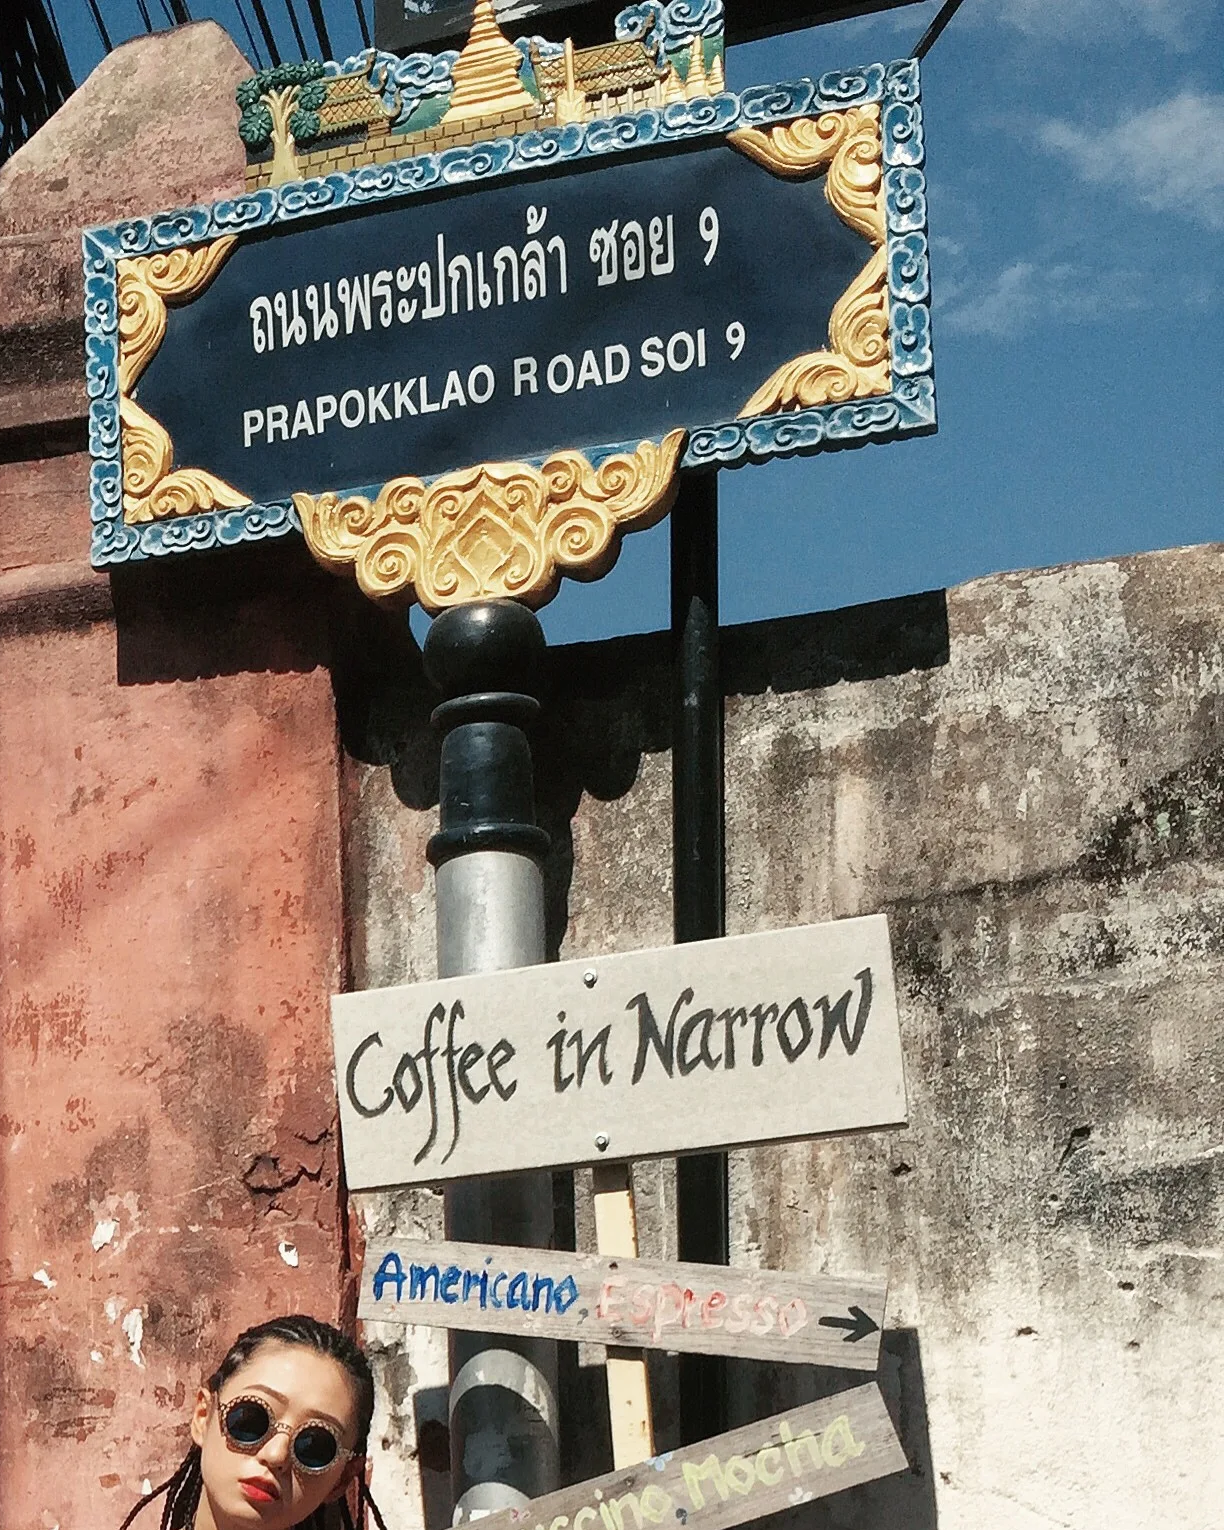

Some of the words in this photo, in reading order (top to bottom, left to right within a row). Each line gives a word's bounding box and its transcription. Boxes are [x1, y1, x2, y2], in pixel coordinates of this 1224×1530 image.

[249, 205, 567, 353] ถนนพระปกเกล้า
[589, 214, 674, 286] ซอย
[698, 206, 719, 266] 9
[243, 364, 495, 447] PRAPOKKLAO
[514, 345, 630, 397] ROAD
[640, 328, 706, 378] SOI
[726, 321, 746, 361] 9
[346, 1000, 517, 1165] Coffee
[547, 1011, 613, 1092] in
[627, 968, 873, 1085] Narrow
[595, 1274, 808, 1343] Espresso
[683, 1415, 866, 1511] Mocha
